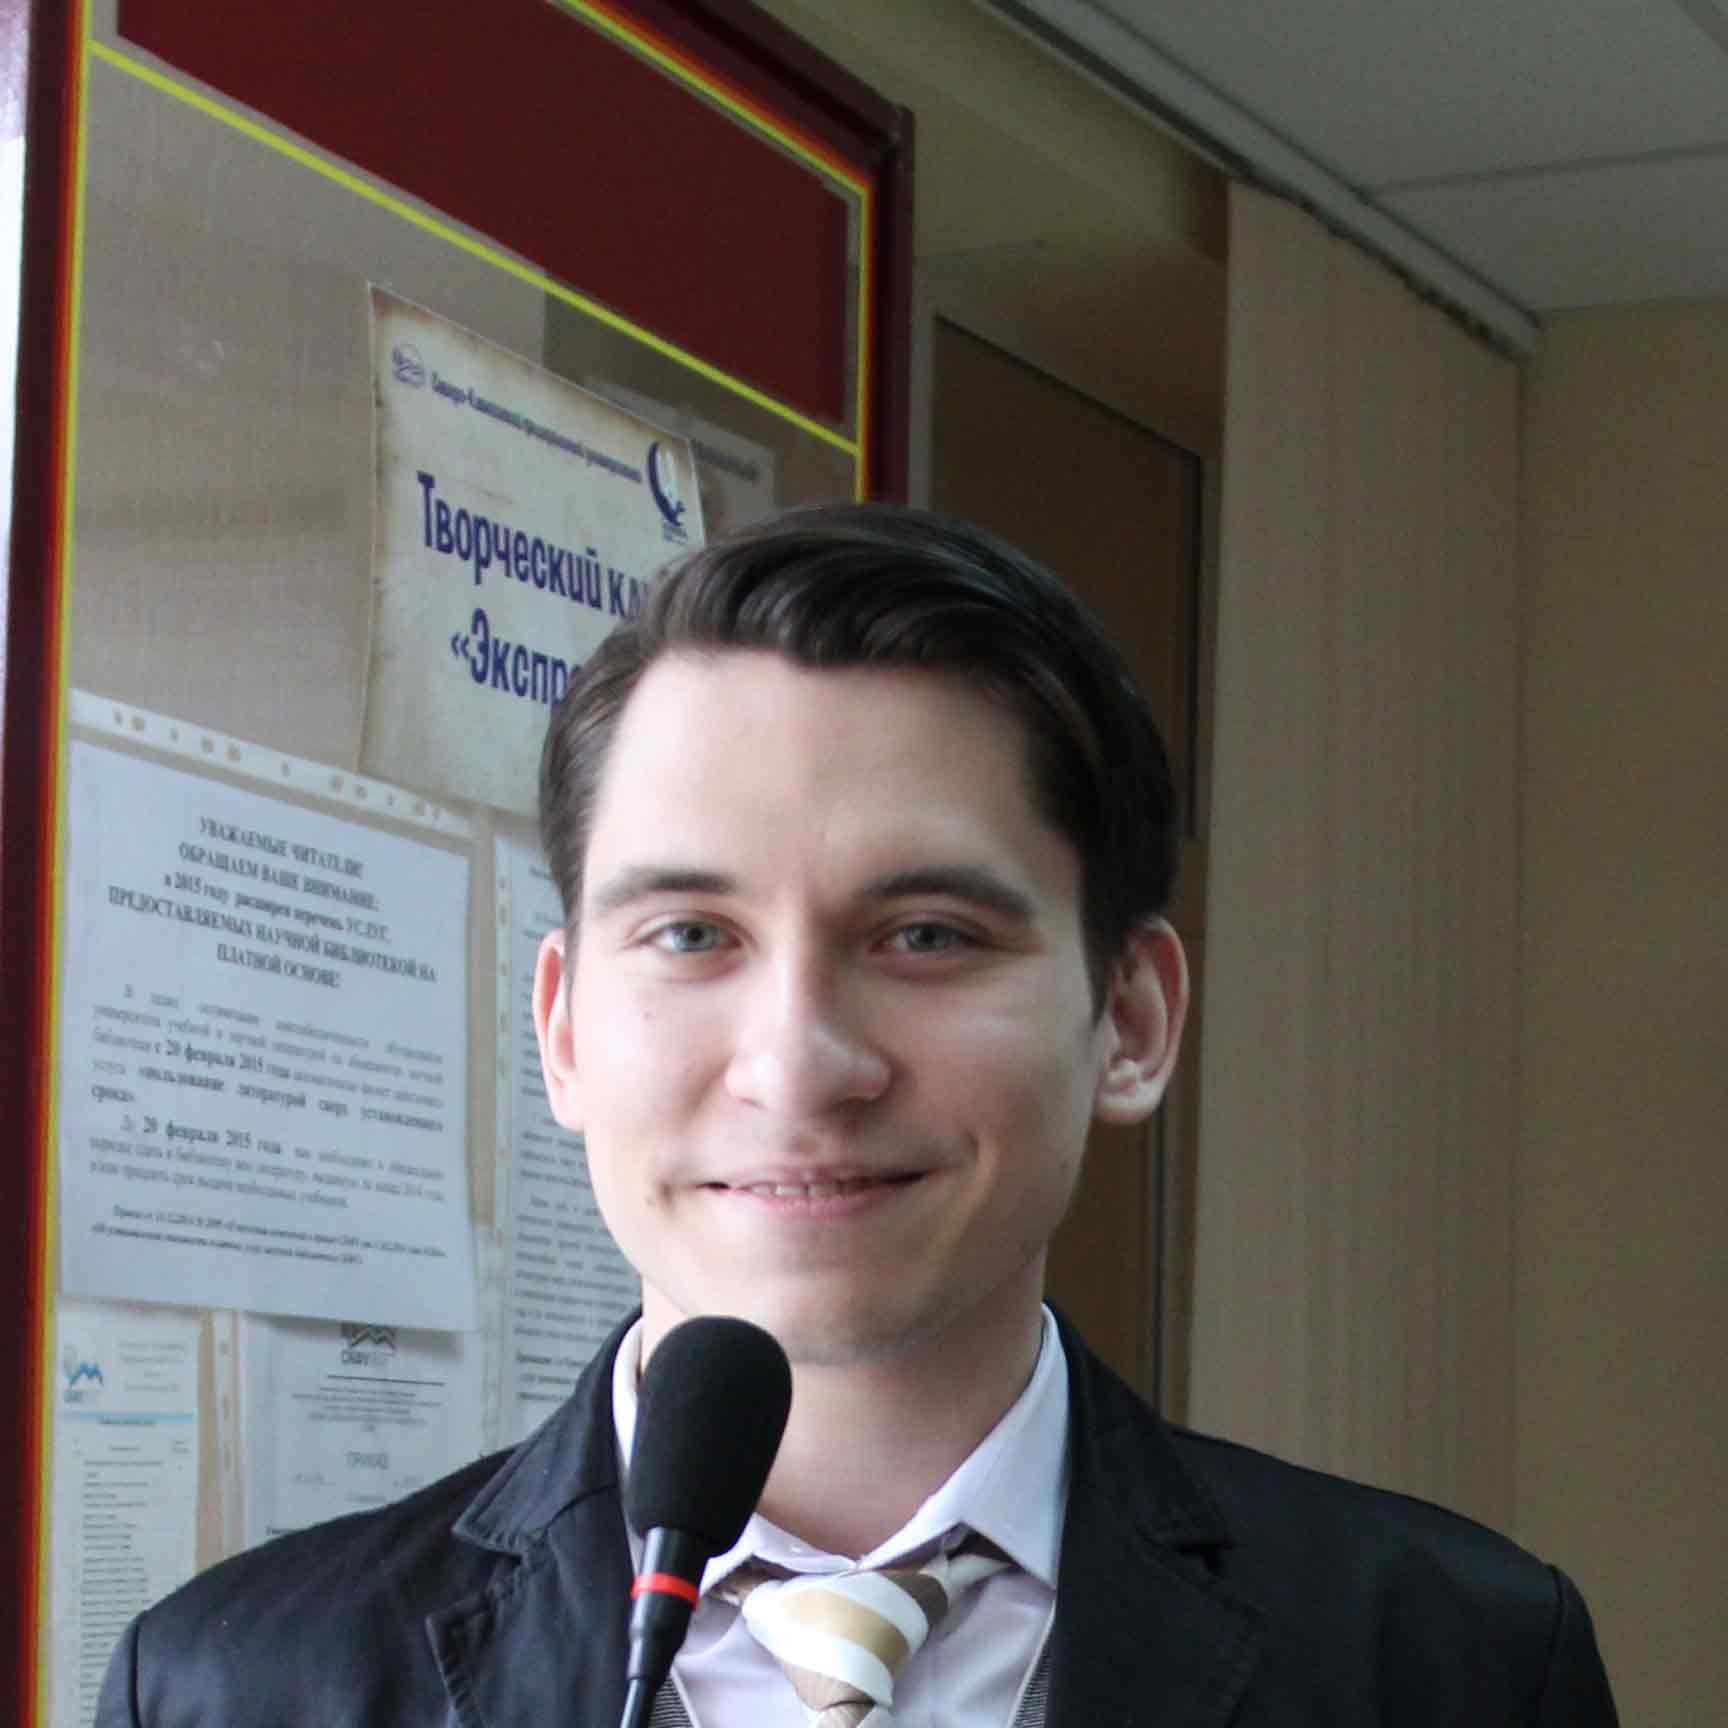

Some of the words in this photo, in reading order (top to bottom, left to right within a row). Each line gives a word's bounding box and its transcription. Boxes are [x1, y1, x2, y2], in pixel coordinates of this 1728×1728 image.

[417, 470, 602, 612] Творческий
[607, 566, 645, 626] кл
[449, 606, 581, 714] «Экспр
[200, 816, 287, 857] УВАЖАЕМЫЕ
[178, 841, 258, 879] ОБРАЩАЕМ
[262, 864, 299, 890] ВАШЕ
[174, 871, 201, 896] 2015
[203, 883, 229, 905] году
[108, 884, 254, 938] ПРЕДОСТАВЛЯЕМЫХ
[256, 925, 321, 956] НАУЧНОЙ
[322, 940, 417, 978] БИБЛИОТЕКОЙ
[418, 962, 437, 983] НА
[216, 942, 282, 976] ПЛАТНОЙ
[183, 1042, 235, 1067] февраля
[238, 1052, 264, 1073] 2015
[165, 1119, 220, 1144] февраля
[225, 1129, 252, 1150] 2015
